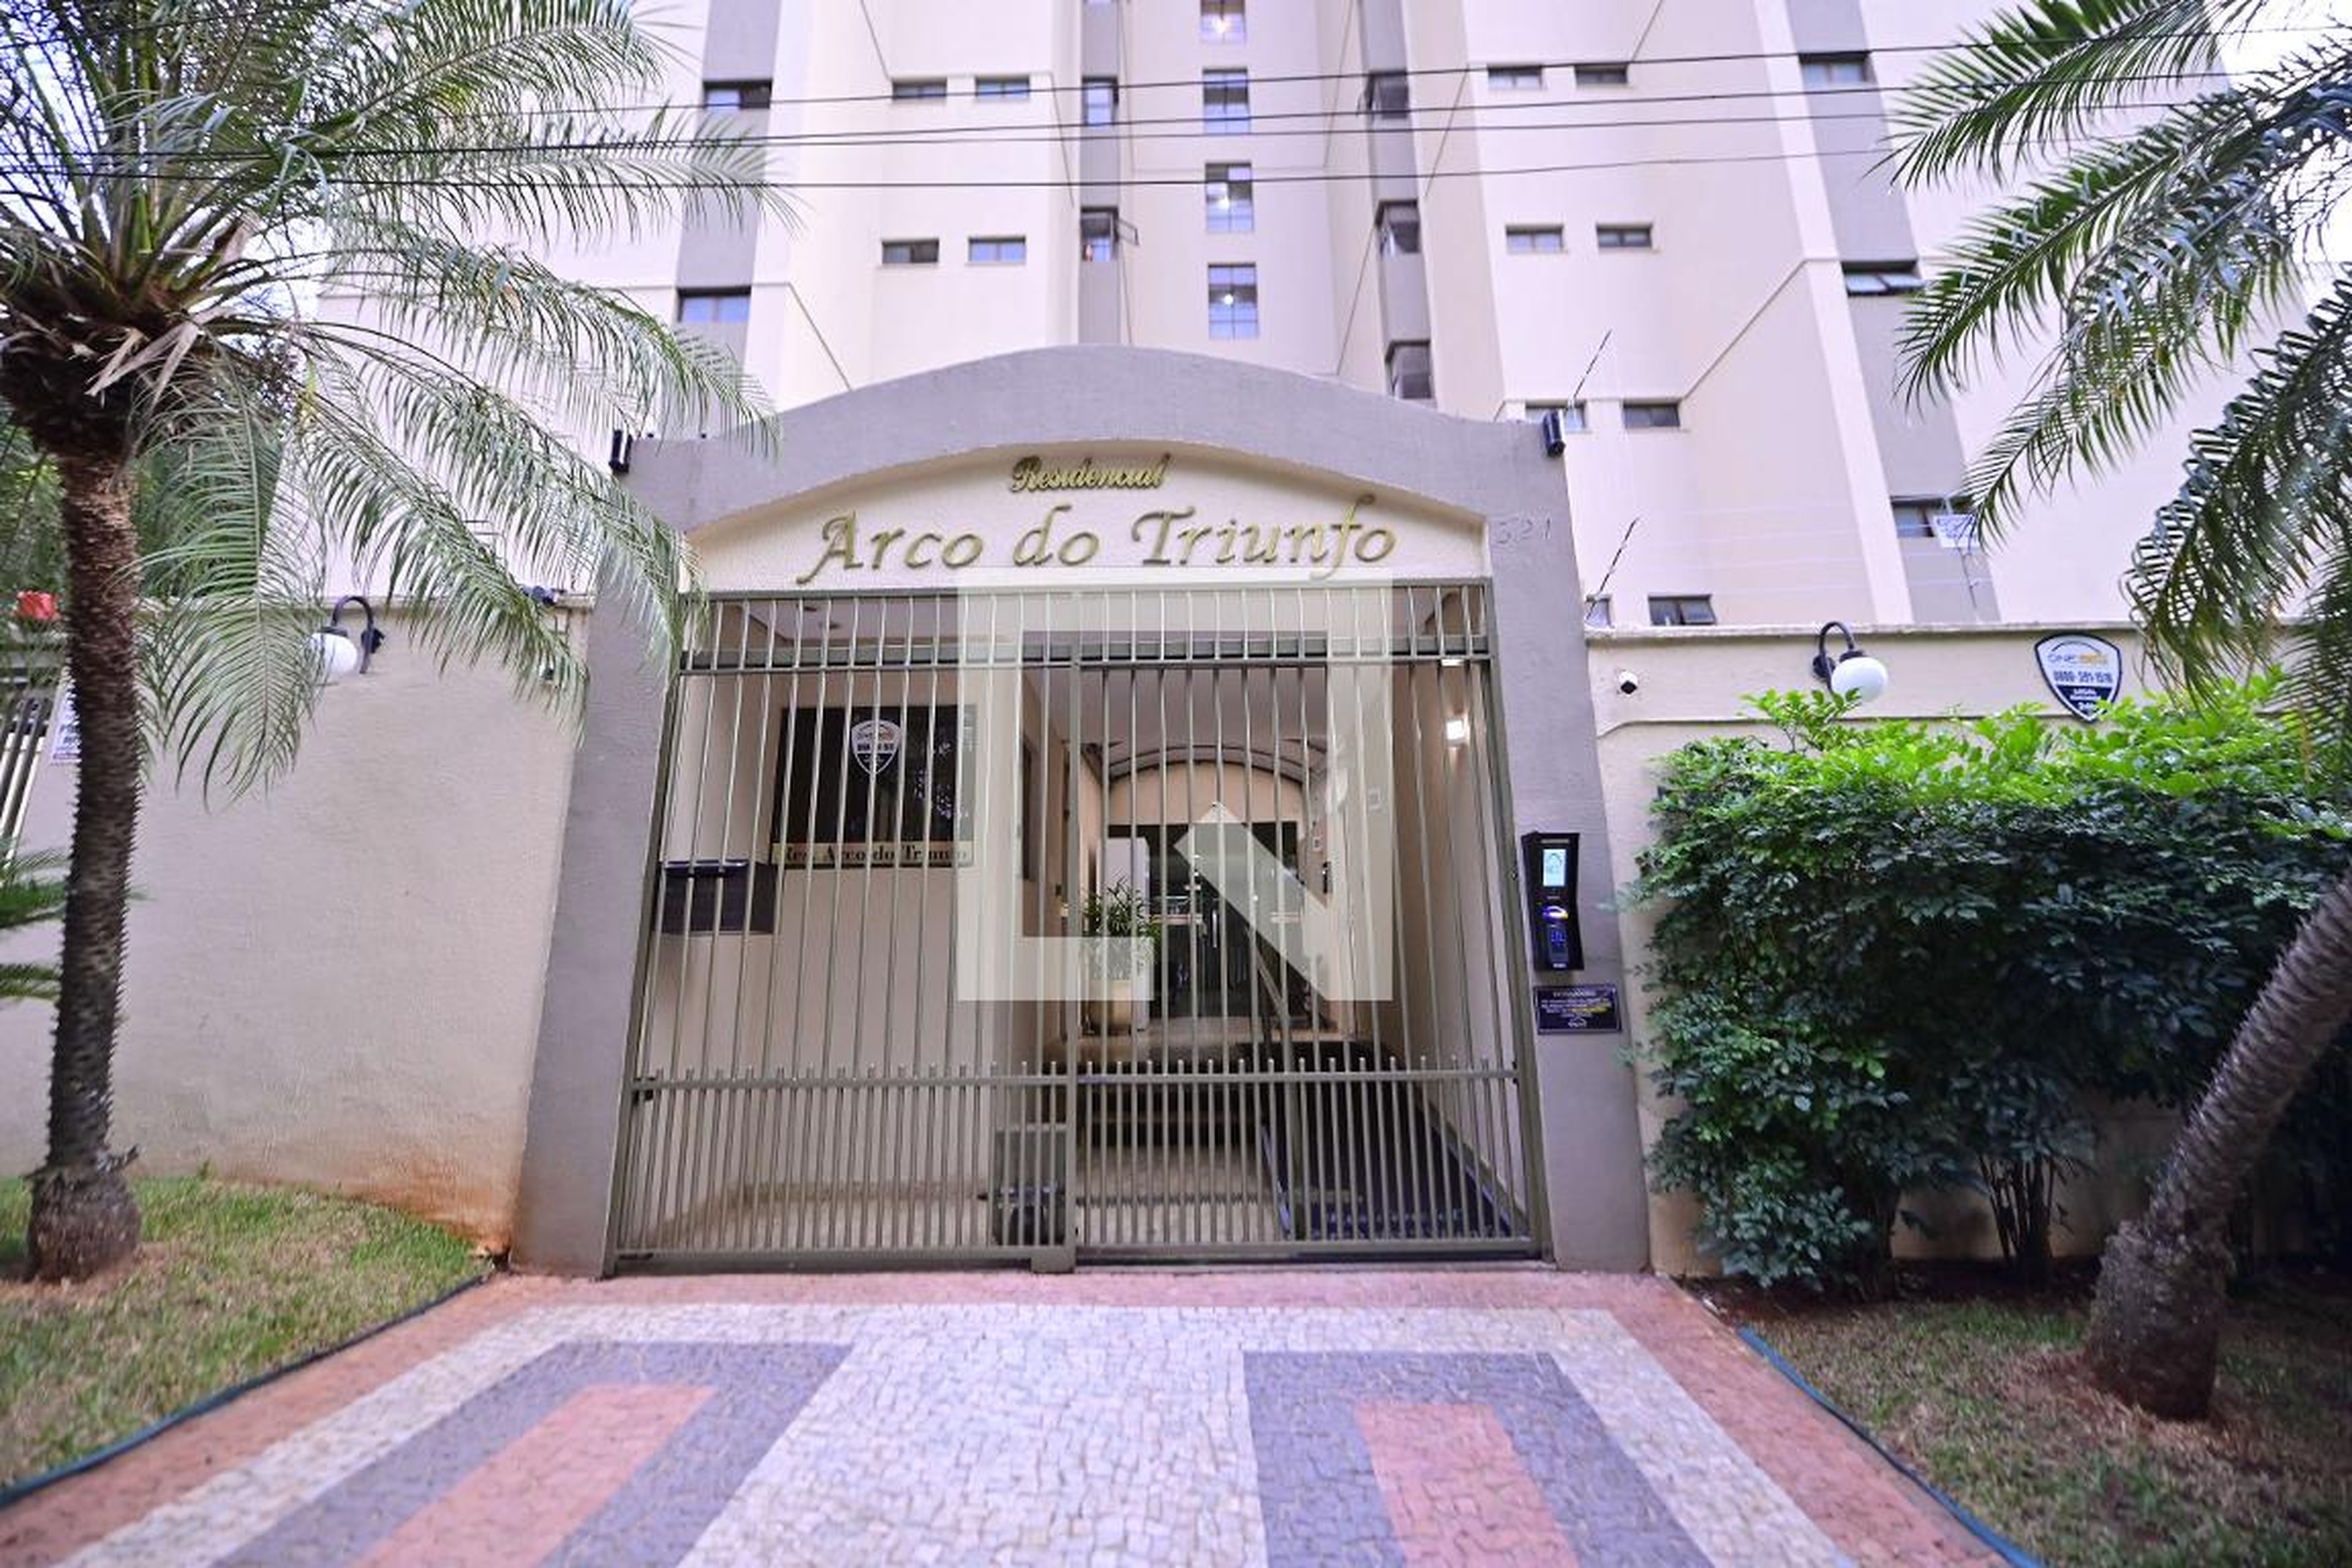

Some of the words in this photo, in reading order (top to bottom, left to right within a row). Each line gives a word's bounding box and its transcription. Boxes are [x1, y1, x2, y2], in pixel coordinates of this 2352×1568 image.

[1011, 453, 1170, 492] Residencial
[796, 510, 984, 585] Arco
[1012, 504, 1099, 567] do
[1131, 492, 1397, 581] Triunfo
